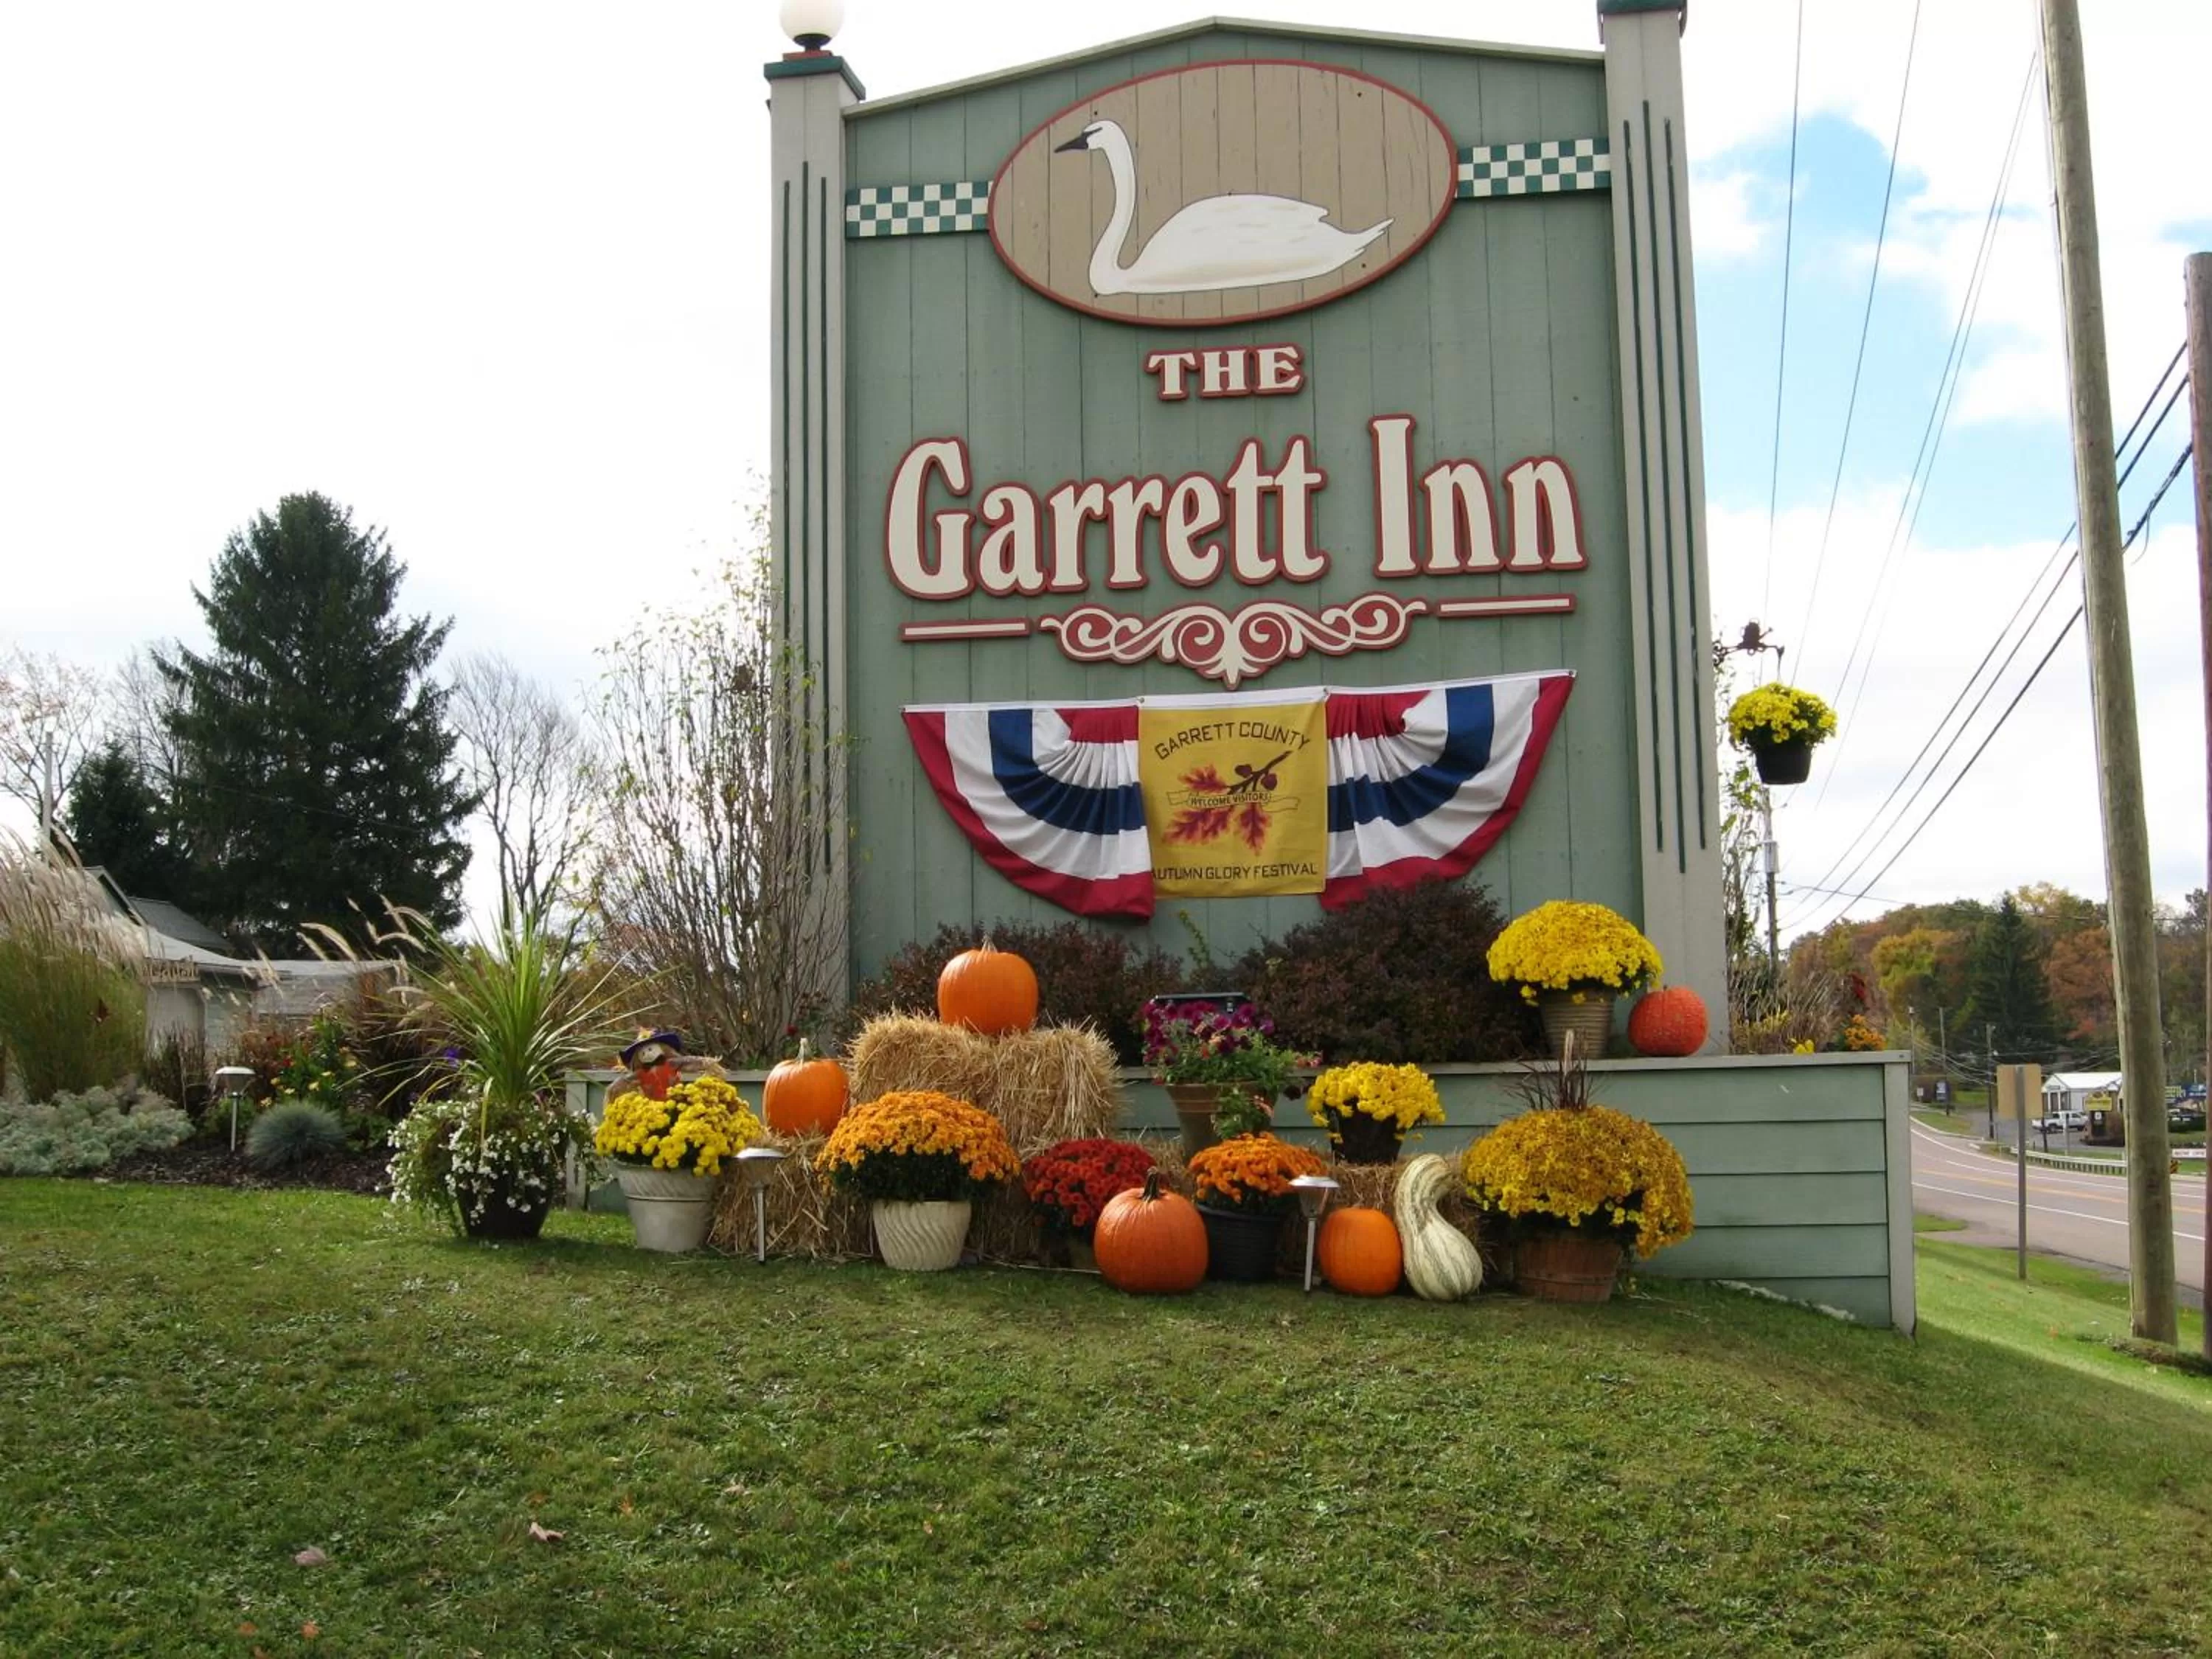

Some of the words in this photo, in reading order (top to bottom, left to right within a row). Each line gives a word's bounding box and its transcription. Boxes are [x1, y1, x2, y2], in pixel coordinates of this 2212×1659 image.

[1144, 344, 1304, 400] THE
[888, 437, 1330, 599] Garrett
[1368, 414, 1587, 577] Inn
[1155, 722, 1234, 760] GARRETT
[1239, 722, 1310, 750] COUNTY
[1191, 794, 1231, 806] WELCOME
[1206, 866, 1251, 880] GLORY
[1253, 863, 1318, 877] FESTIVAL
